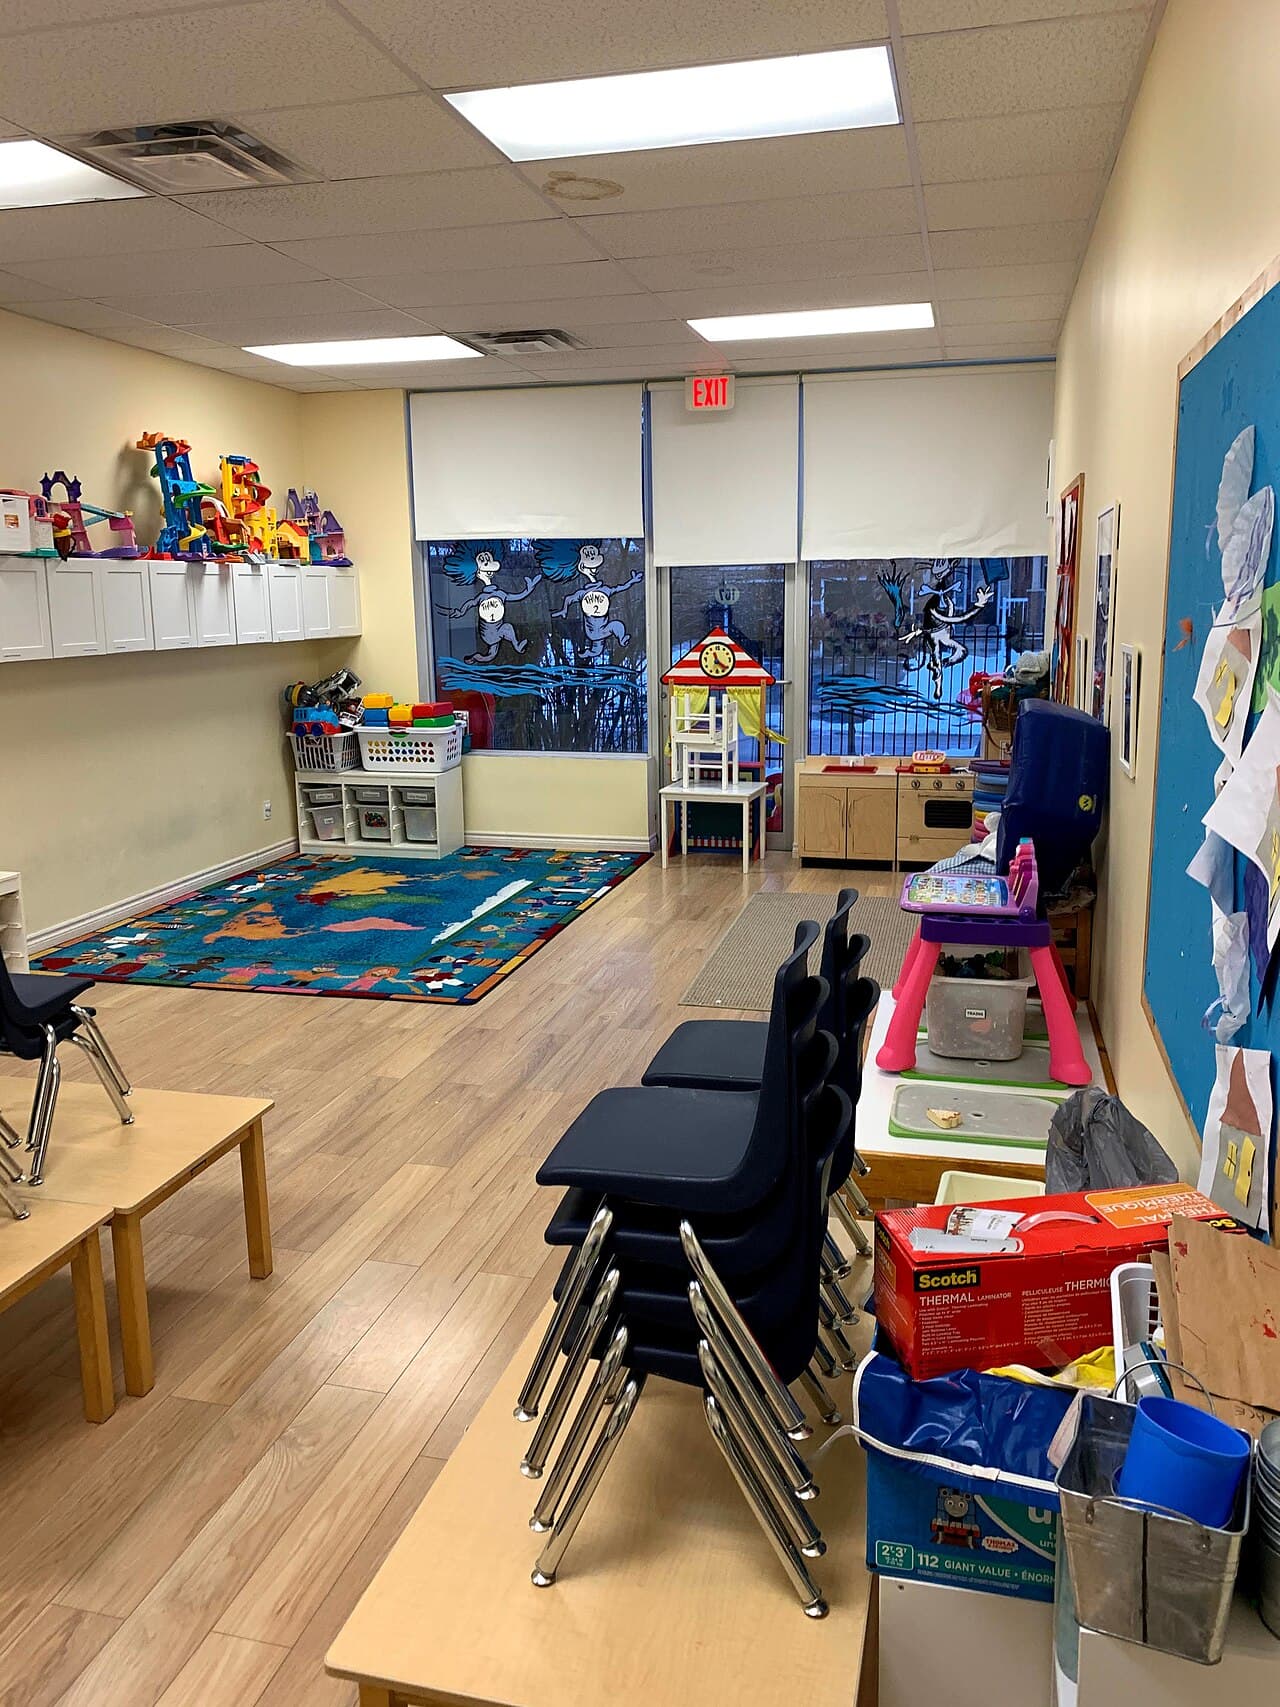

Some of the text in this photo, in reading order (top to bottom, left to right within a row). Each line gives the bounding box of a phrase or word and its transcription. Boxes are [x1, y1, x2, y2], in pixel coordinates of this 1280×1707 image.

[693, 377, 729, 408] EXIT
[480, 600, 499, 611] THING
[583, 594, 605, 605] THING
[593, 605, 601, 614] 2
[490, 613, 496, 621] 1
[1102, 1192, 1202, 1214] THERMIQUE
[919, 1270, 977, 1289] Scotch
[1022, 1286, 1064, 1297] PELLICULEUSE
[920, 1292, 1012, 1307] THERMAL LAMINATOR
[917, 1553, 939, 1568] 112
[944, 1559, 976, 1572] GIANT
[978, 1565, 1011, 1577] VALUE
